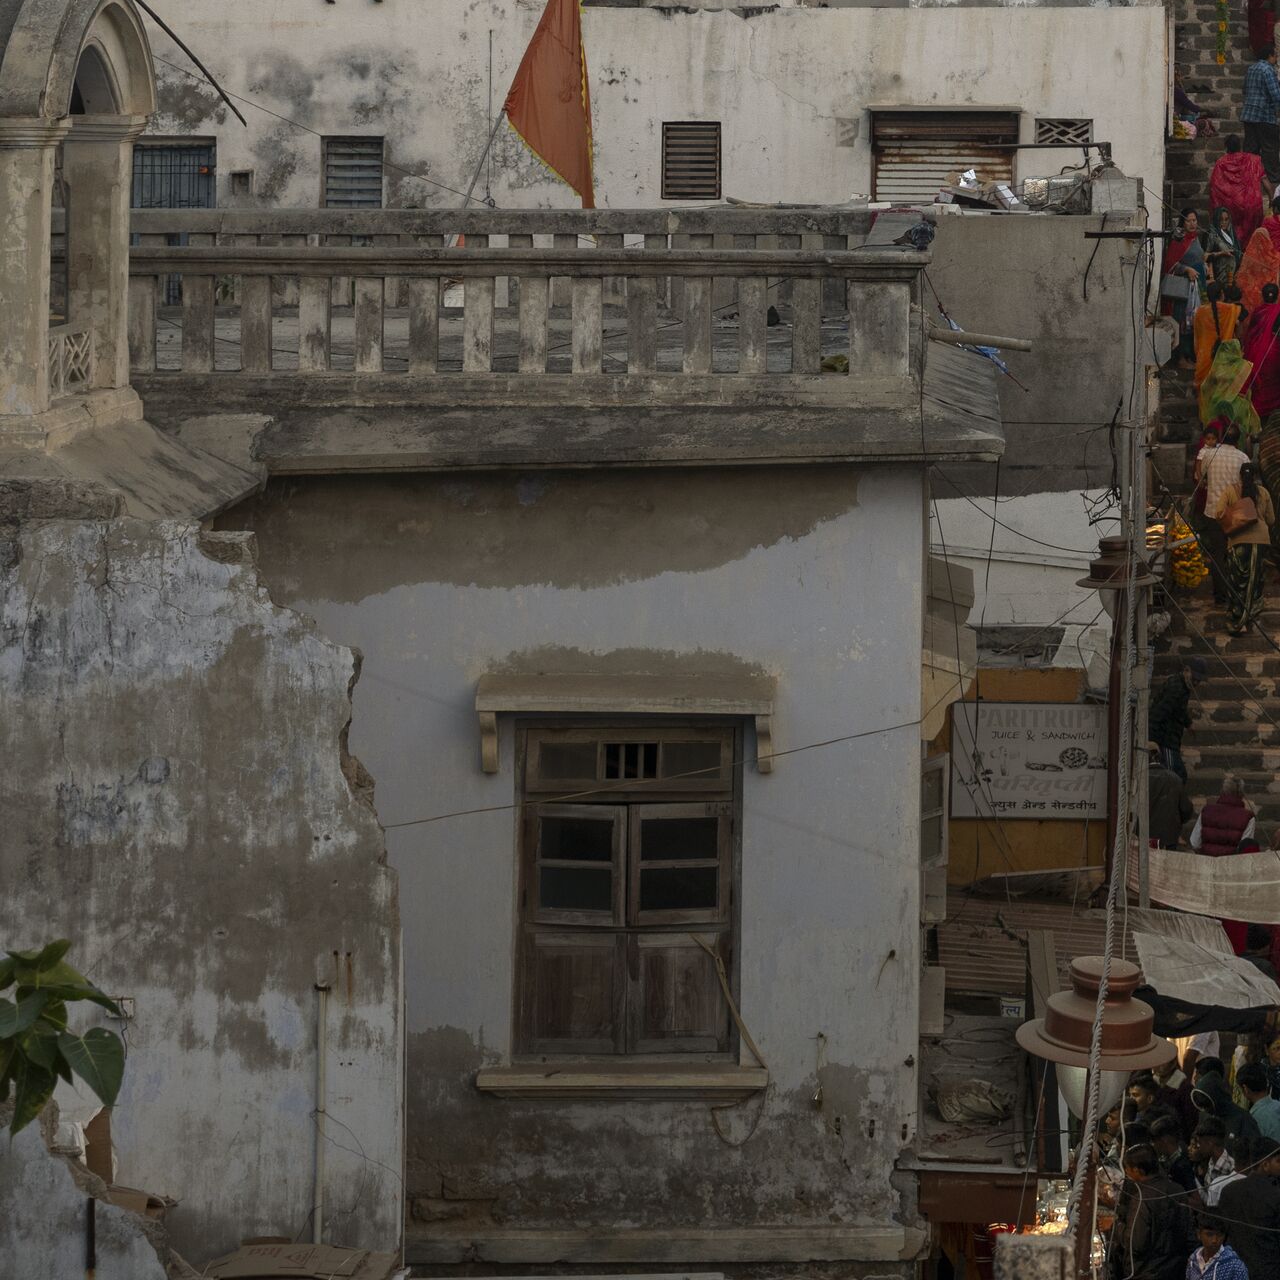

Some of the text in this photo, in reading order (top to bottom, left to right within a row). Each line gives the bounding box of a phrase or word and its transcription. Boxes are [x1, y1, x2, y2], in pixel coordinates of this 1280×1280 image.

[991, 730, 1096, 741] JUICE & SANDWICH
